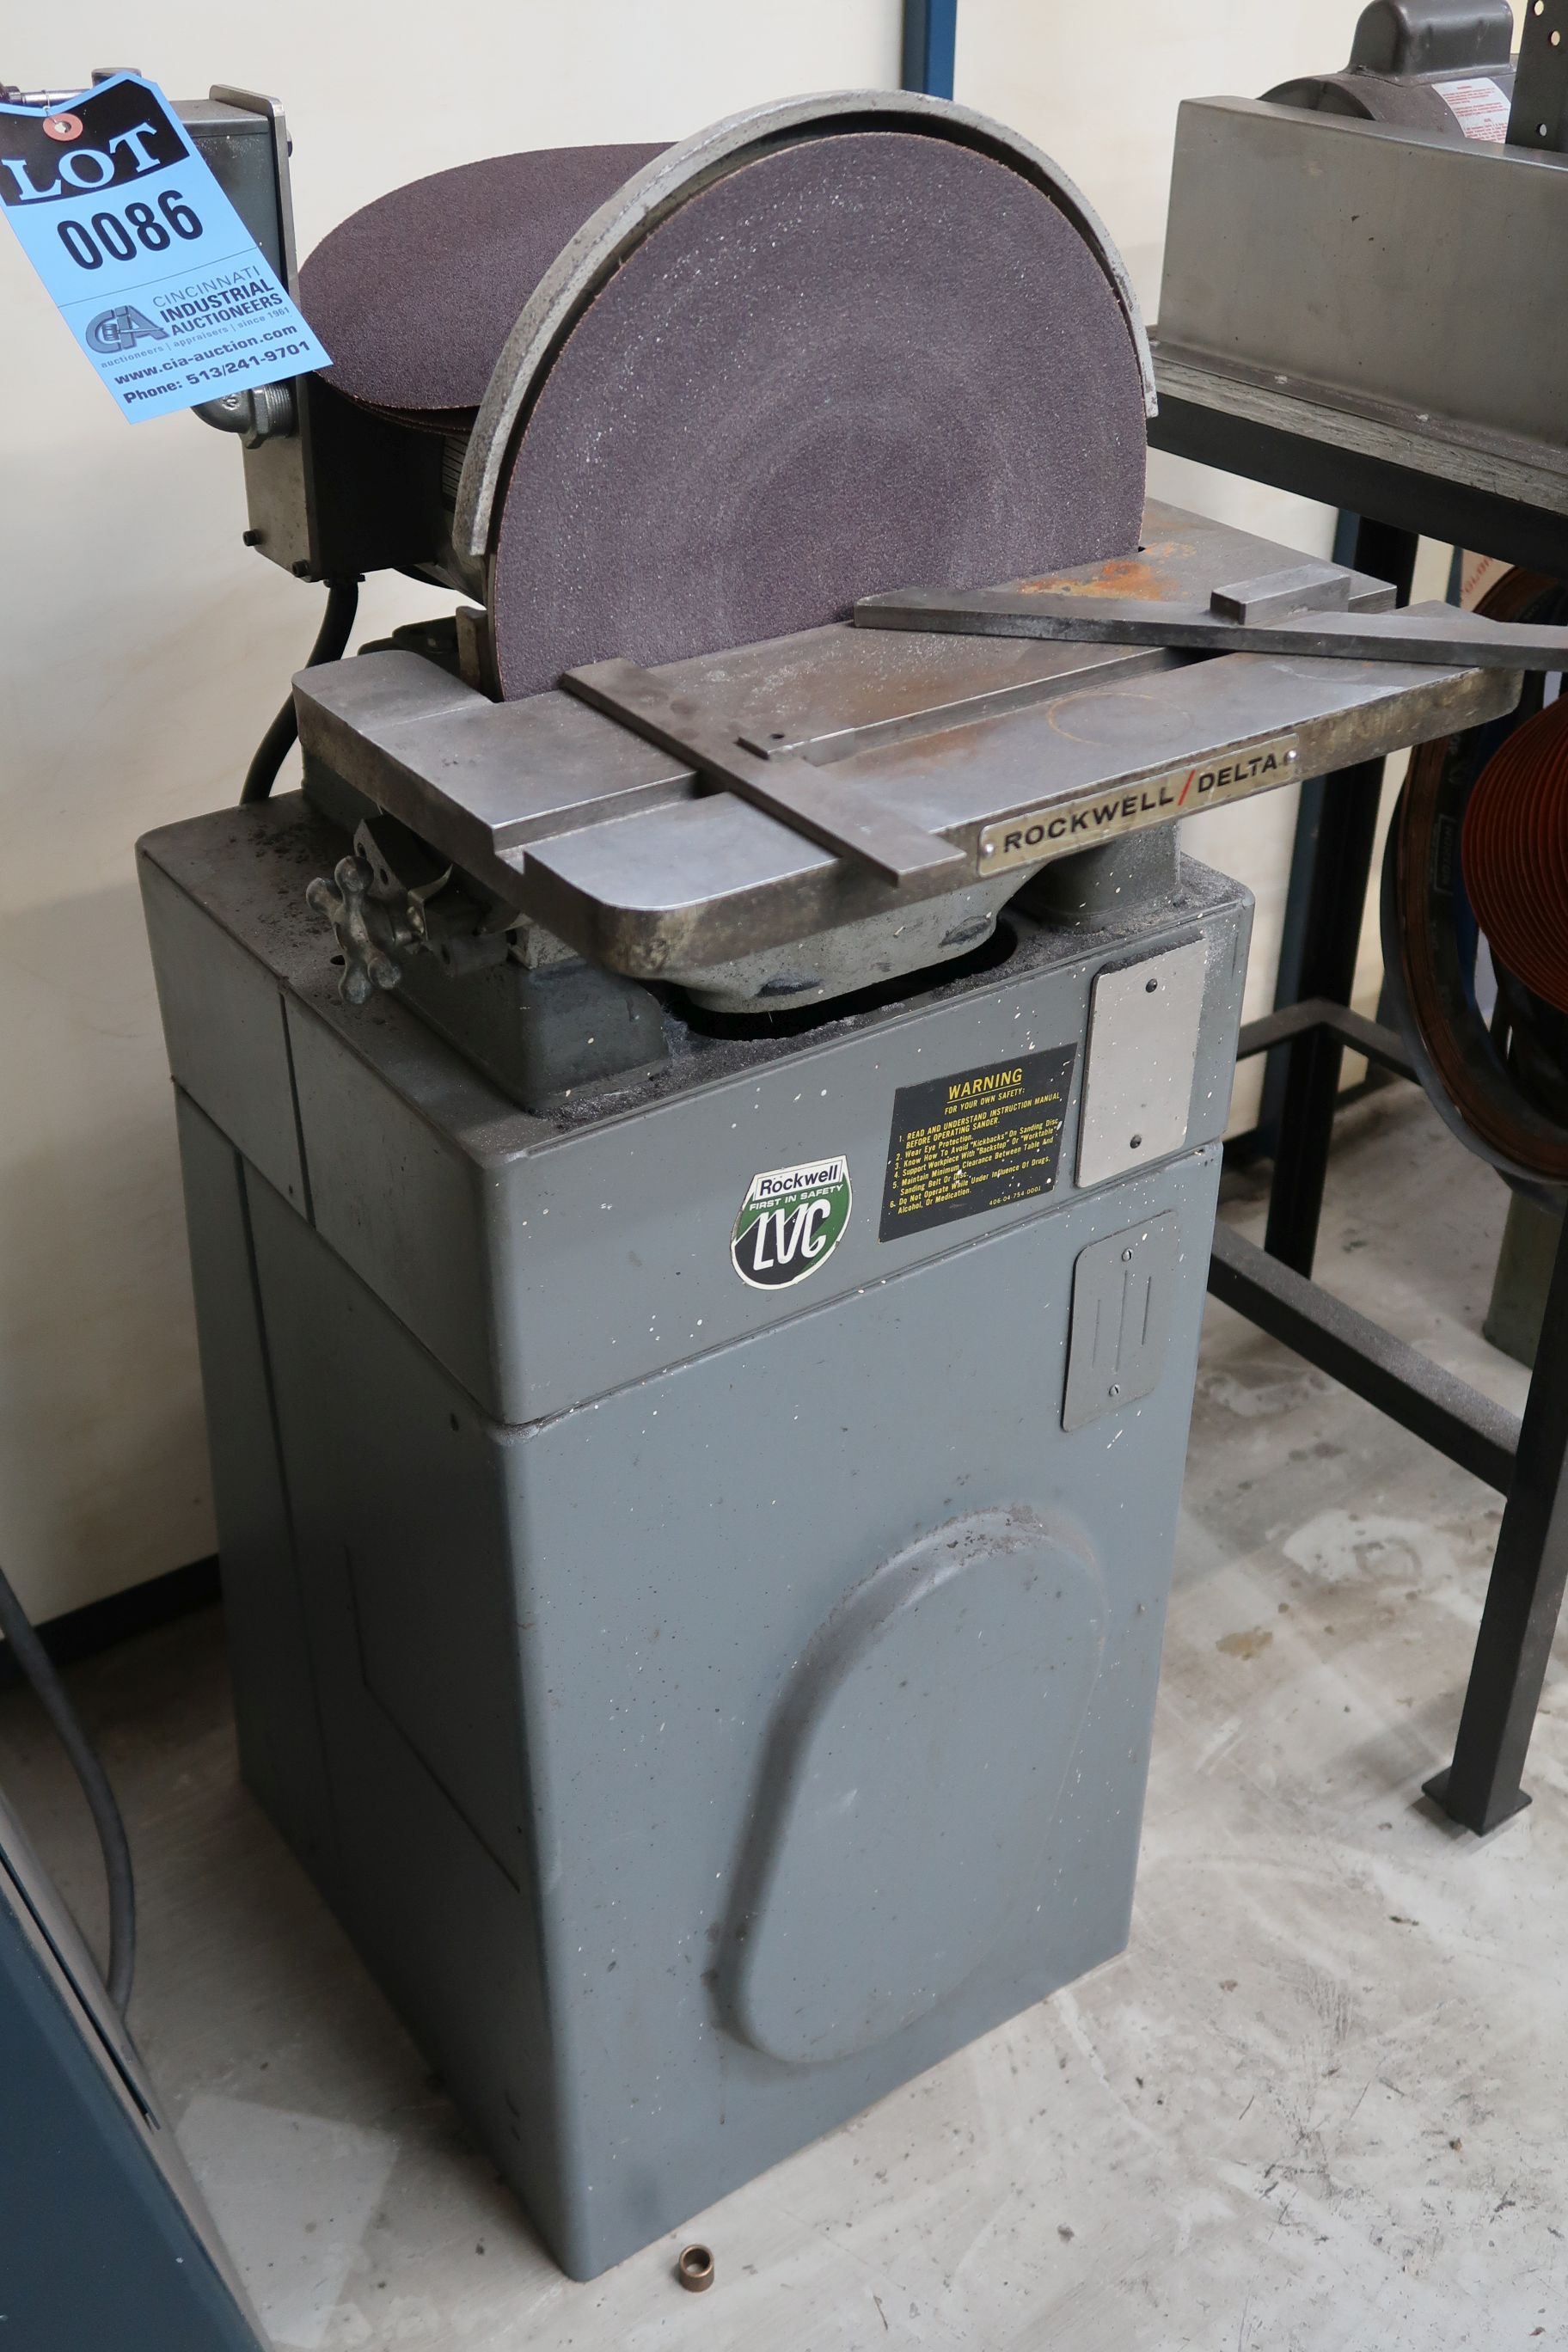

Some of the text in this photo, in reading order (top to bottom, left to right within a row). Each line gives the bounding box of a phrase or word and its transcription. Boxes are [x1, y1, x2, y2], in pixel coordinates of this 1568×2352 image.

[1, 122, 161, 200] LOT
[57, 190, 204, 271] 0086
[153, 266, 260, 307] CINCINNATI
[160, 279, 274, 323] INDUSTRIAL
[172, 293, 283, 336] AUCTIONEERS
[101, 307, 291, 369] auctioneers appraisers since 1961
[114, 325, 297, 385] www.cia-auction.com
[123, 340, 310, 404] Phone: 513/241-9701
[945, 1087, 1025, 1115] FOR YOUR OWN SAFETY:
[948, 1068, 1023, 1100] WARNING
[906, 1117, 1000, 1149] BEFORE OPERATING SANDER.
[907, 1129, 925, 1140] READ
[928, 1124, 941, 1135] AND
[943, 1112, 987, 1130] UNDERSTAND
[990, 1099, 1032, 1117] INSTRUCTION
[892, 1136, 1054, 1189] 5. Maintain Minimum Clearance Between Table And
[896, 1135, 973, 1161] 2. Wear Eye Protection.
[903, 1157, 922, 1167] Know
[923, 1153, 938, 1162] How
[940, 1148, 948, 1157] To
[951, 1142, 969, 1154] Avoid
[971, 1131, 1008, 1148] "Kickbacks"
[1020, 1123, 1043, 1135] Sanding
[903, 1163, 927, 1177] Support
[928, 1155, 959, 1169] Workpiece
[961, 1149, 976, 1160] With
[977, 1139, 1010, 1155] "Backstop"
[750, 1184, 843, 1211] FIRST IN SAFETY
[760, 1165, 837, 1196] Rockwell
[900, 1183, 926, 1196] Sanding
[928, 1178, 941, 1187] Belt
[910, 1193, 922, 1202] Not
[923, 1185, 949, 1198] Operate
[952, 1180, 969, 1190] While
[971, 1173, 989, 1185] Under
[991, 1165, 1020, 1179] Influence
[1021, 1161, 1029, 1169] Of
[1032, 1156, 1050, 1167] Drugs.
[935, 1189, 971, 1204] Medication.
[753, 1198, 831, 1271] LVC
